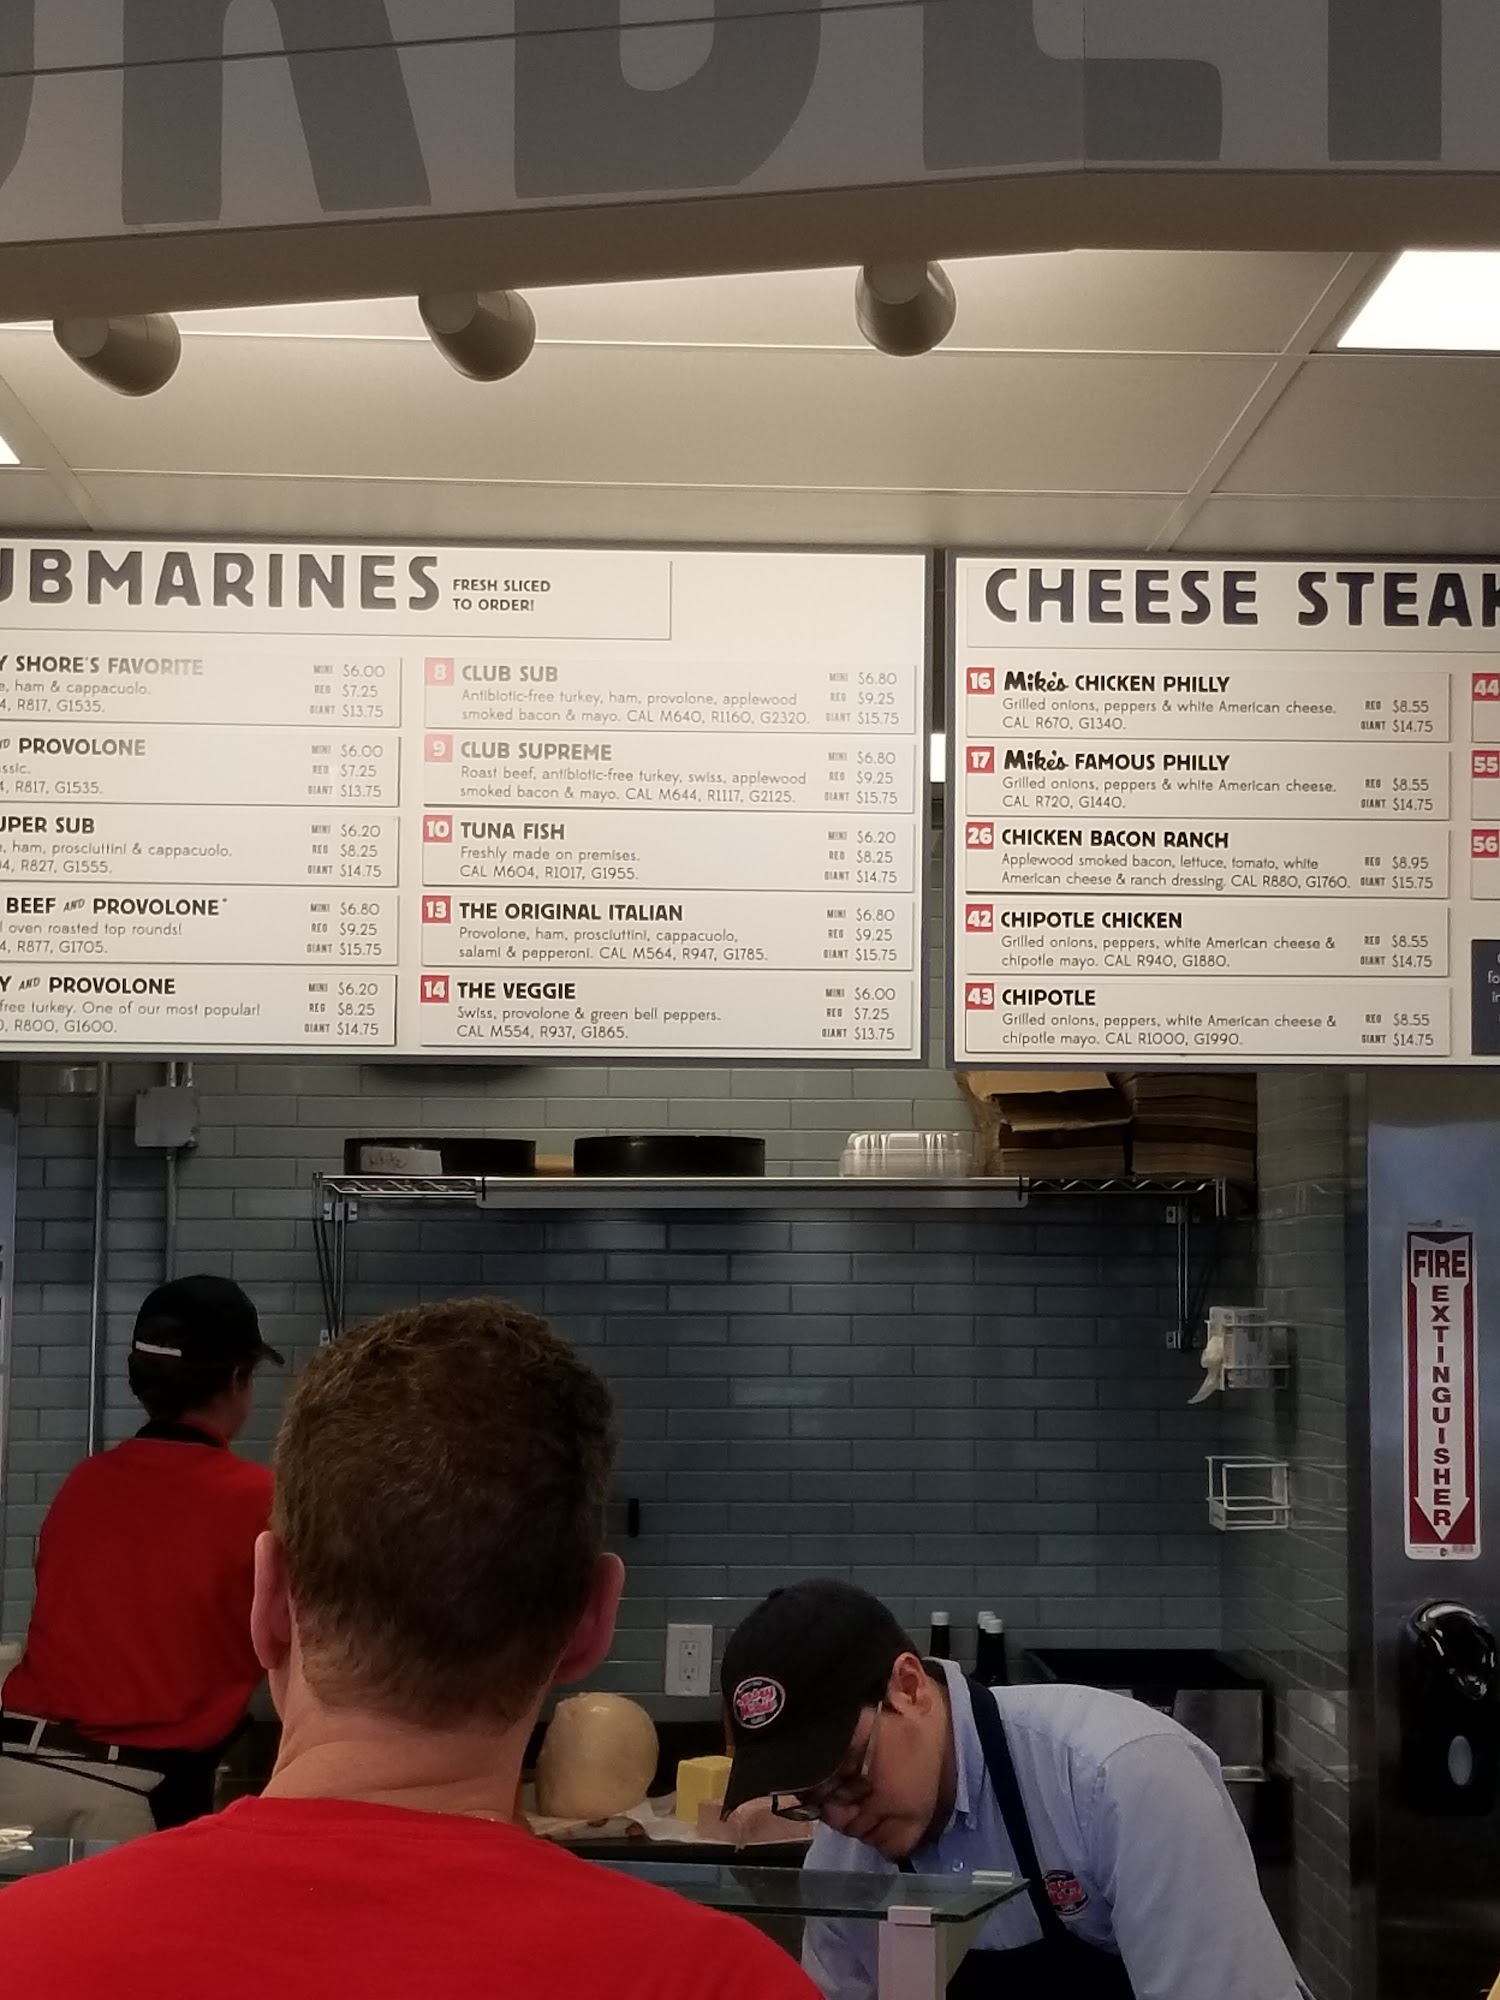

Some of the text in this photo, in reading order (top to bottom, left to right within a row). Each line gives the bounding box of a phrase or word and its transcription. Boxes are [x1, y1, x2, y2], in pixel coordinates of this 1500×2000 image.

[452, 579, 551, 592] FRESH SLICED
[985, 568, 1259, 625] CHEESE
[452, 598, 535, 611] TO ORDER!
[15, 656, 100, 673] SHORE'S
[108, 658, 204, 675] FAVORITE
[342, 664, 386, 677] $6.00
[433, 663, 558, 682] 8 CLUB SUB
[857, 672, 898, 685] $6.80
[969, 671, 1231, 692] 16 Mike's CHICKEN PHILLY
[1474, 679, 1499, 696] 44
[341, 684, 379, 697] $7.25
[857, 692, 895, 705] $9.25
[341, 704, 384, 717] $13.75
[1002, 697, 1337, 714] Grilled onions, peppers & white American cheese.
[1392, 700, 1430, 713] $8.55
[857, 711, 900, 725] $15.75
[1002, 716, 1127, 730] CAL R670, G1340.
[1391, 719, 1434, 733] $14.75
[18, 738, 146, 756] PROVOLONE
[340, 744, 384, 757] $6.00
[431, 741, 612, 761] 9 CLUB SUPREME
[856, 751, 897, 764] $6.80
[970, 750, 1230, 771] 17 Mike's FAMOUS PHILLY
[339, 764, 377, 777] $7.25
[1474, 756, 1499, 773] 55
[855, 771, 894, 784] $9.25
[340, 784, 382, 797] $13.75
[1392, 778, 1430, 791] $8.55
[856, 791, 898, 804] $15.75
[1392, 798, 1434, 811] $14.75
[55, 817, 95, 834] SUB
[340, 824, 382, 837] $6.20
[426, 821, 565, 840] 10 TUNA FISH
[856, 830, 897, 843] $6.20
[968, 827, 1229, 848] 26 CHICKEN BACON RANCH
[339, 844, 378, 857] $8.25
[1472, 836, 1498, 854] 56
[460, 846, 641, 863] Freshly made on premises.
[855, 850, 894, 863] $8.25
[1001, 853, 1319, 870] Applewood smoked bacon, lettuce, tomato, white
[1391, 856, 1429, 869] $8.95
[339, 864, 382, 877] $14.75
[459, 865, 639, 880] CAL M604, R1017, G1955.
[856, 870, 898, 883] $14.75
[1391, 876, 1434, 889] $15.75
[6, 898, 57, 913] BEEF
[63, 899, 85, 911] AND
[339, 902, 381, 915] $6.80
[426, 901, 683, 921] 13 THE ORIGINAL ITALIAN
[855, 908, 896, 921] $6.80
[968, 910, 1182, 928] 42 CHIPOTLE CHICKEN
[339, 922, 378, 935] $9.25
[855, 928, 893, 941] $9.25
[1391, 935, 1429, 948] $8.55
[339, 942, 382, 956] $15.75
[459, 945, 768, 961] salami & pepperoni. CAL M564, R947, G1785.
[855, 948, 898, 961] $15.75
[1391, 954, 1433, 967] $14.75
[18, 978, 41, 990] AND
[48, 977, 176, 994] PROVOLONE
[337, 982, 379, 995] $6.20
[423, 981, 576, 999] 14 THE VEGGIE
[854, 987, 896, 1000] $6.00
[968, 988, 1096, 1005] 43 CHIPOTLE
[31, 1000, 261, 1018] turkey. One of our most popular!
[337, 1002, 376, 1016] $8.25
[457, 1006, 722, 1024] Swiss, provolone & green bell peppers.
[853, 1007, 890, 1020] $7.25
[14, 1019, 118, 1033] R800, G1600.
[1392, 1013, 1430, 1026] $8.55
[336, 1022, 379, 1035] $14.75
[456, 1025, 629, 1039] CAL M554, R937, G1865.
[854, 1027, 895, 1040] $13.75
[1002, 1031, 1243, 1048] chipotle mayo. CAL R1000, G1990.
[1392, 1033, 1434, 1046] $14.75
[1413, 1249, 1467, 1278] FIRE
[1430, 1285, 1452, 1527] EXTINGUISHER
